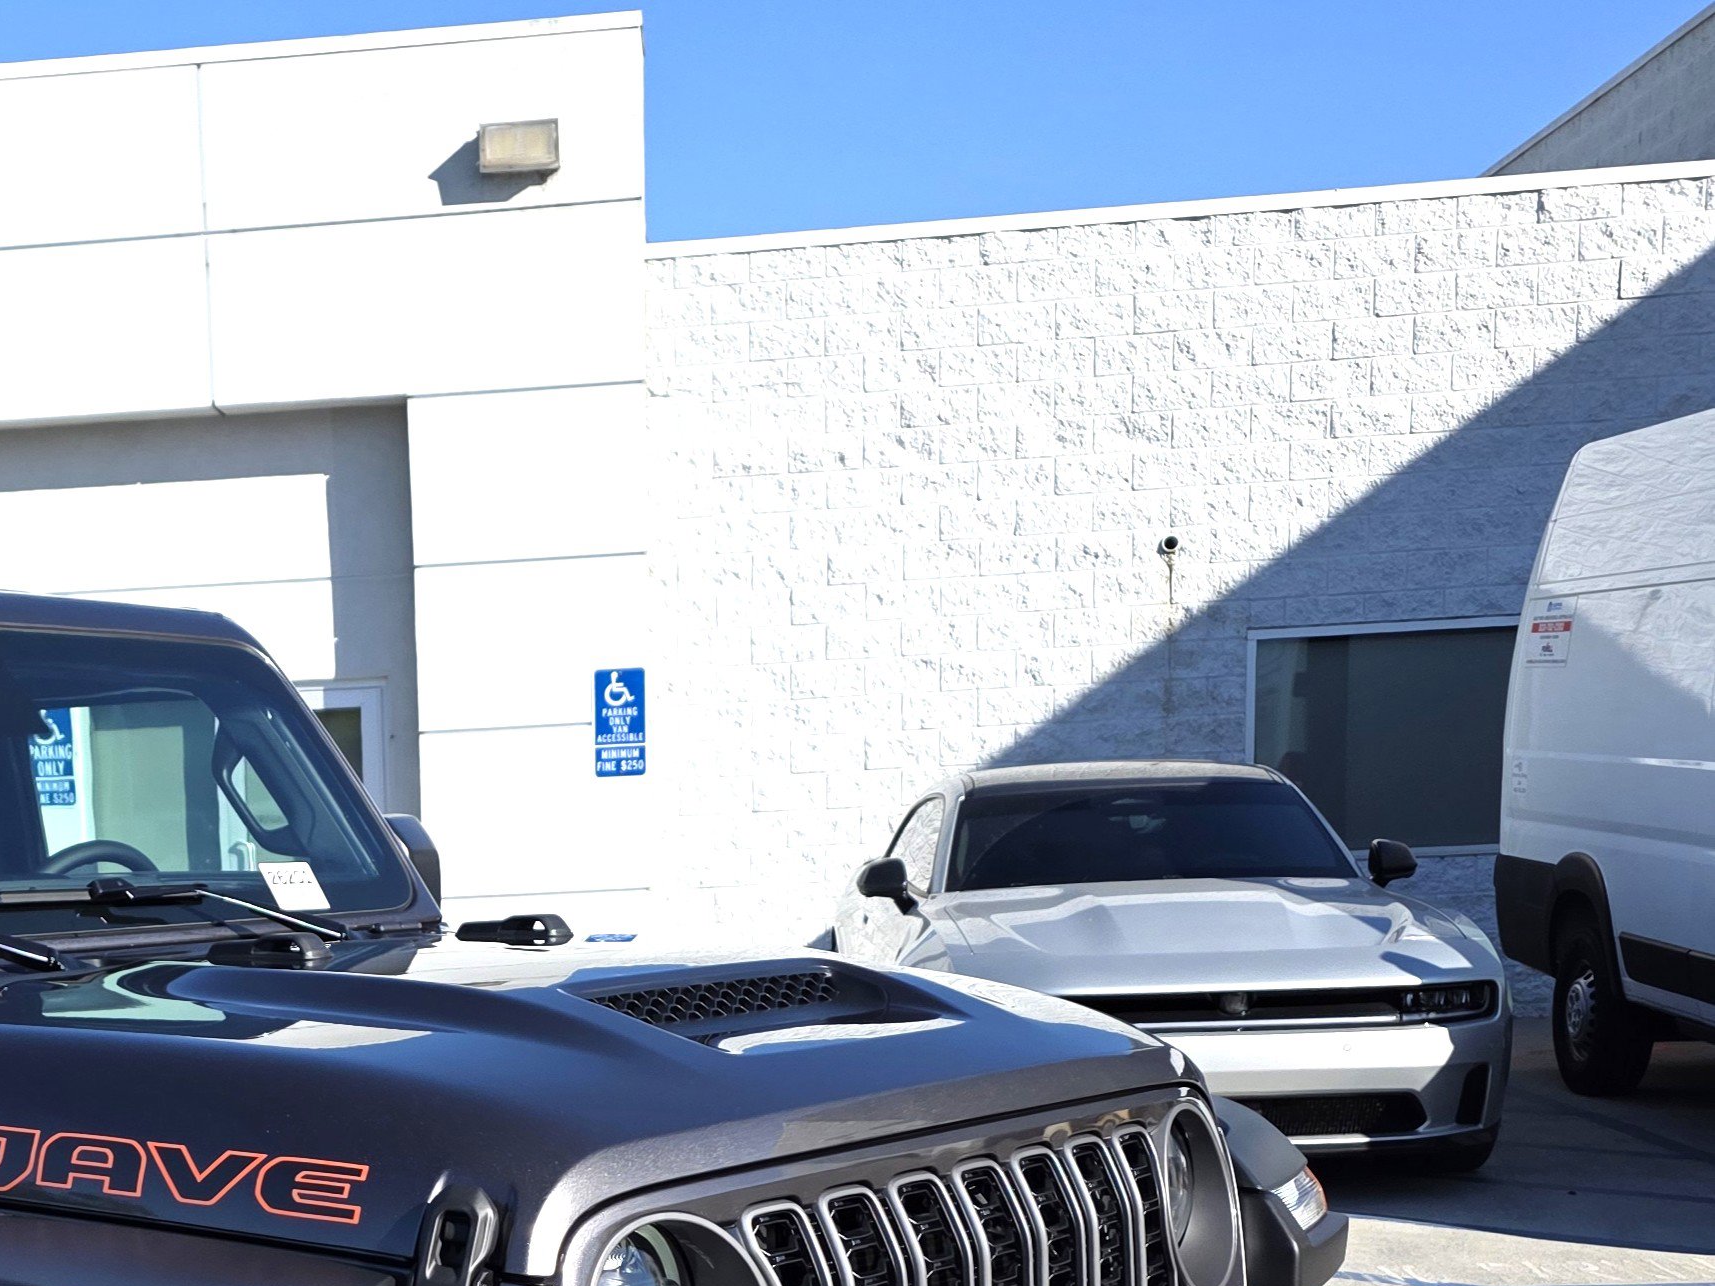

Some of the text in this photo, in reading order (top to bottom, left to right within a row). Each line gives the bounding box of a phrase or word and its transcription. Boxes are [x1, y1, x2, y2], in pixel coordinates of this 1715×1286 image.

[602, 707, 638, 717] PARKING
[609, 716, 631, 726] ONLY
[613, 725, 629, 733] VAN
[597, 732, 643, 743] ACCESSIBLE
[29, 743, 72, 760] PARKING
[601, 748, 640, 759] MINIMUM
[37, 760, 65, 776] ONLY
[596, 760, 645, 771] FINE $250
